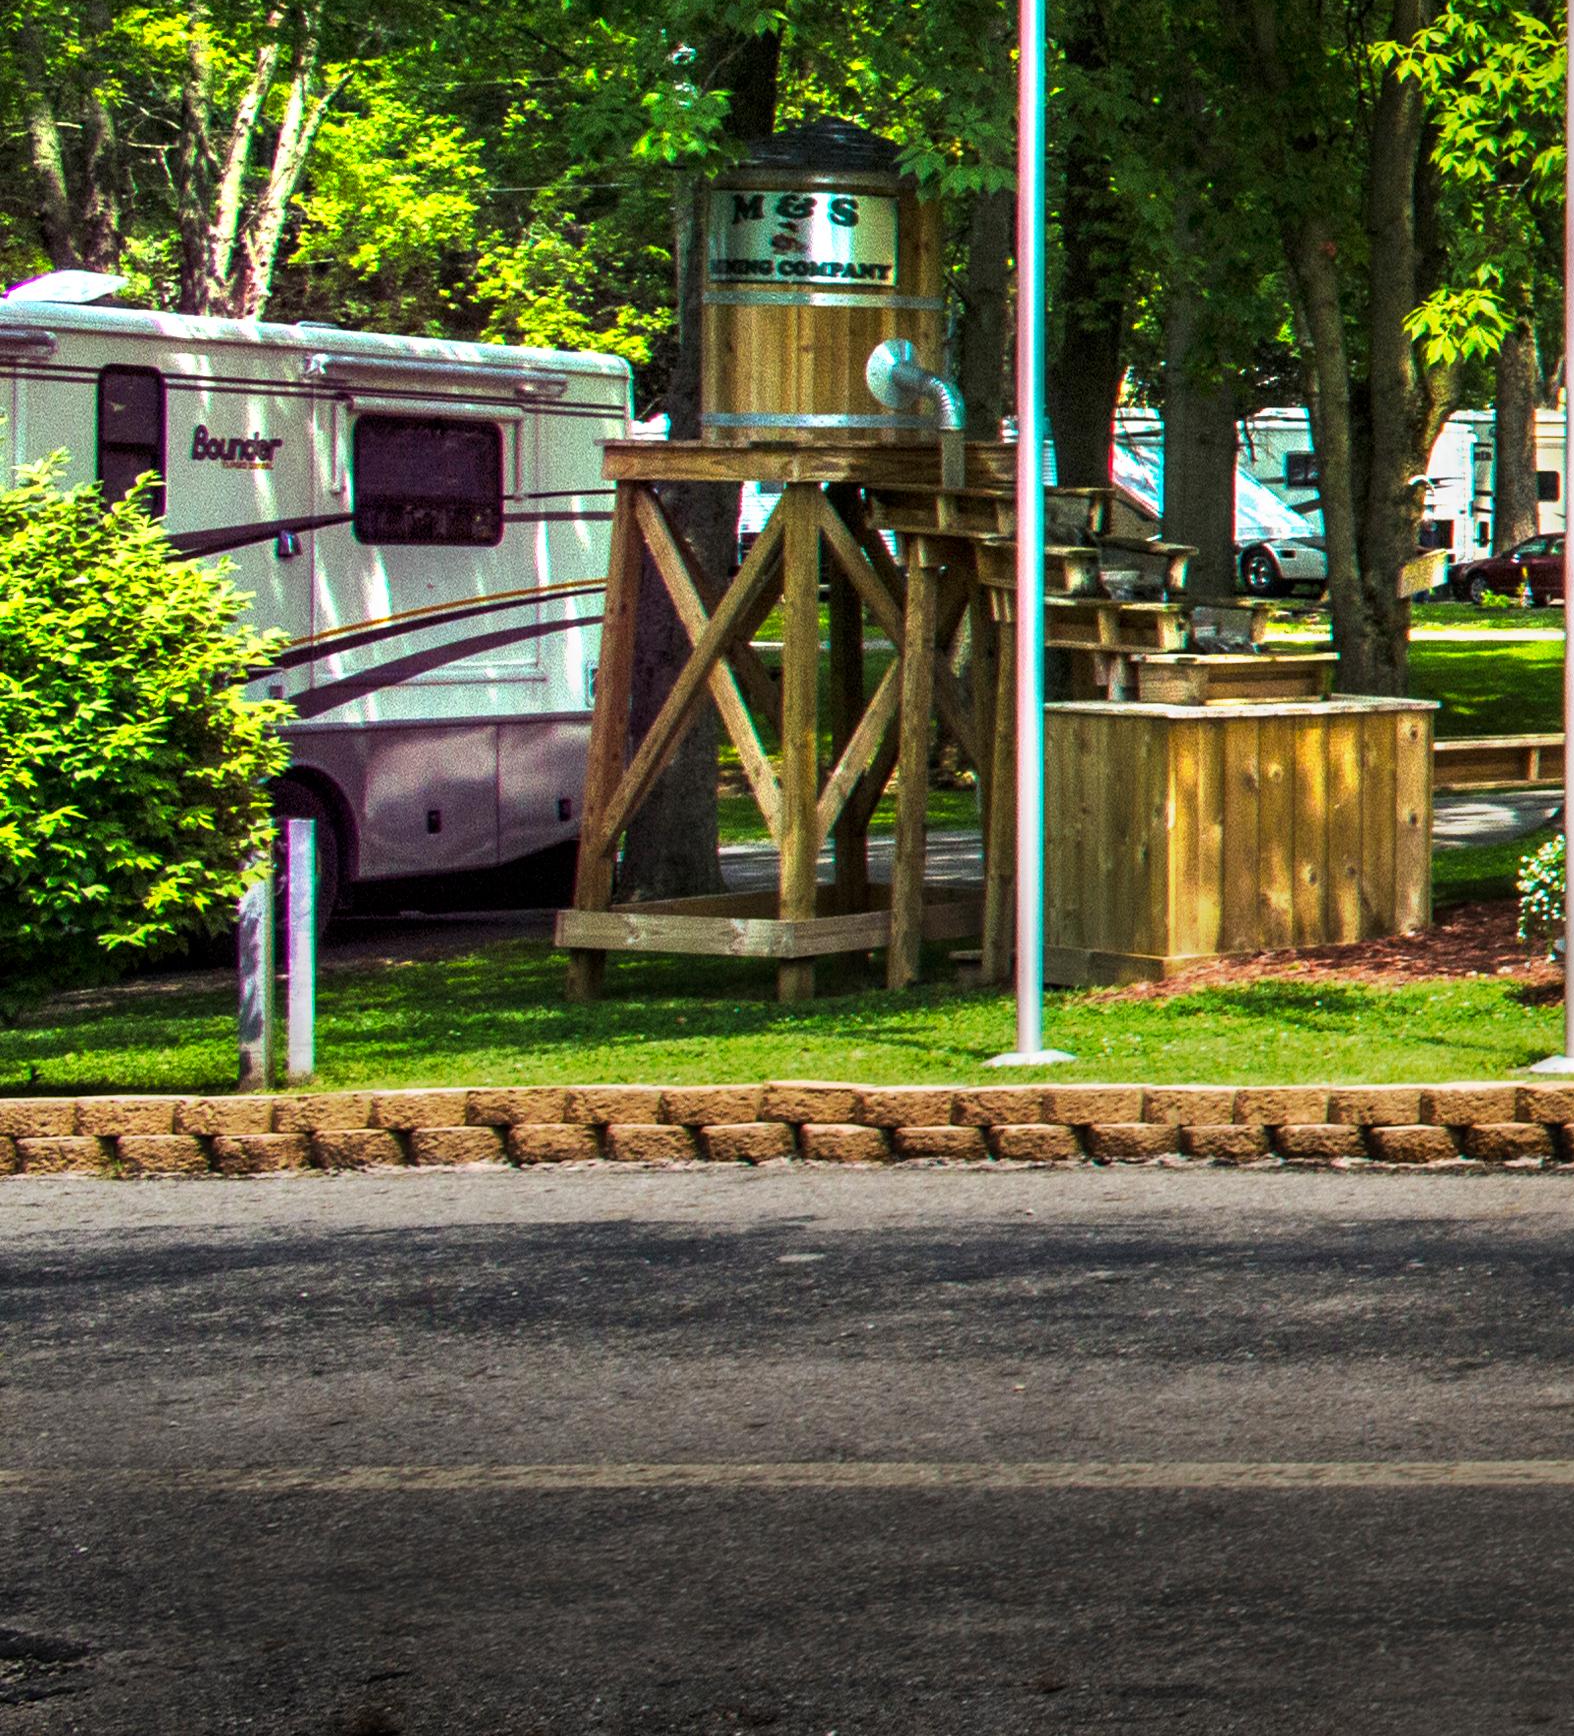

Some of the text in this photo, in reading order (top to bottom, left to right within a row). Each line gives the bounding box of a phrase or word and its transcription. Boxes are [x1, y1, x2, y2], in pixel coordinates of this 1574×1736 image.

[732, 193, 859, 227] M & S
[777, 261, 892, 280] COMPANY
[191, 424, 283, 461] Bounder
